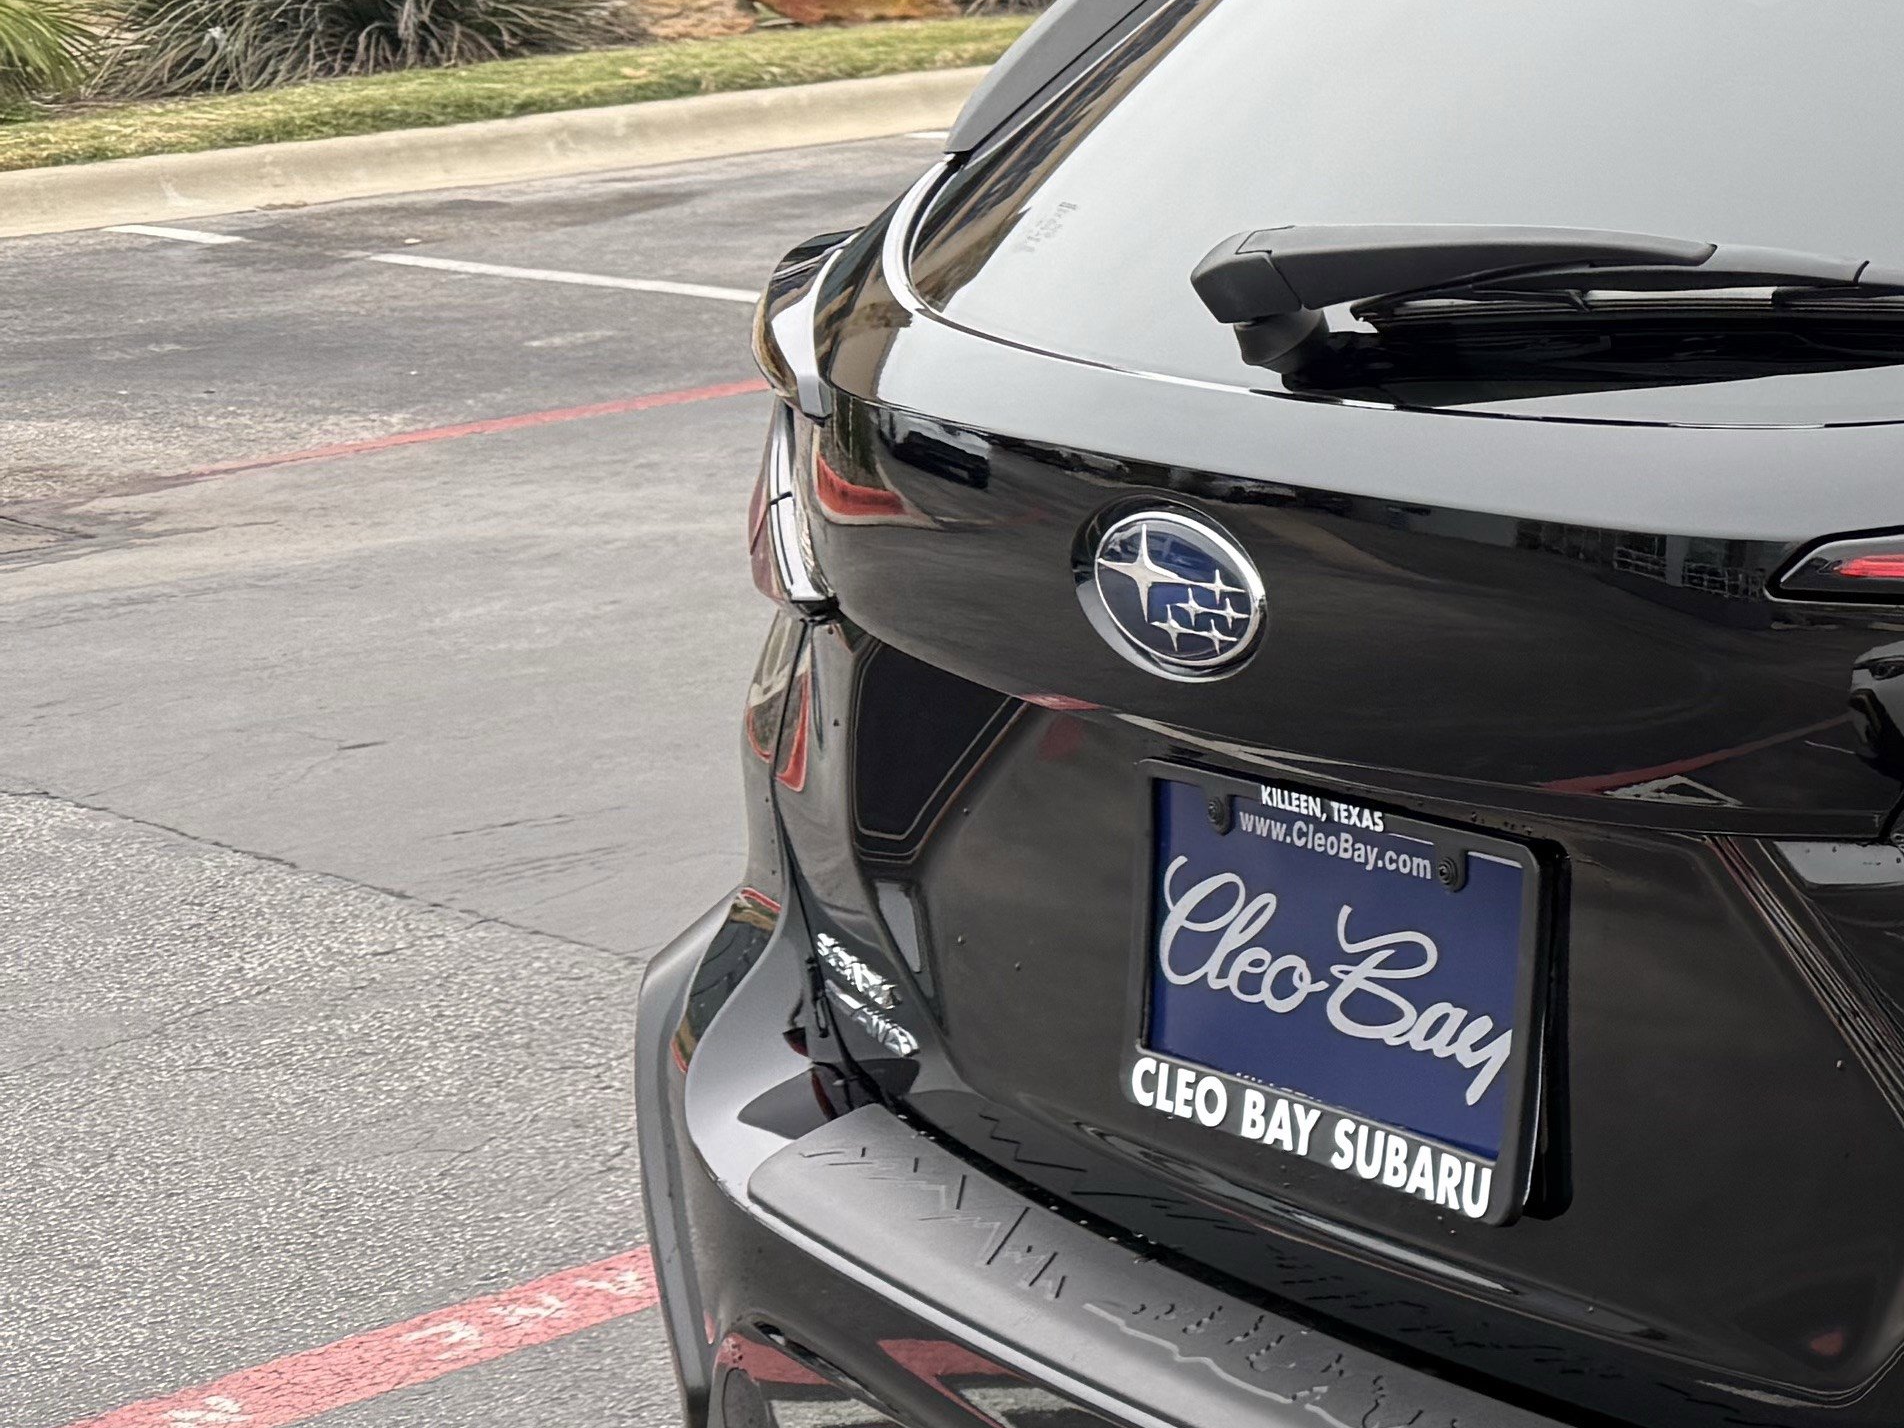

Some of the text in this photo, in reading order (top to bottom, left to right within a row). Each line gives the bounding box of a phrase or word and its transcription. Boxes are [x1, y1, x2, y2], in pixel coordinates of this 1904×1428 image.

[1238, 810, 1433, 880] www.CleoBay.com
[1260, 784, 1385, 833] KILLEEN, TEXAS
[1159, 854, 1514, 1107] Cleo Bay
[1131, 1057, 1228, 1128] CLEO
[1240, 1088, 1322, 1157] BAY
[1330, 1118, 1493, 1220] SUBARU
